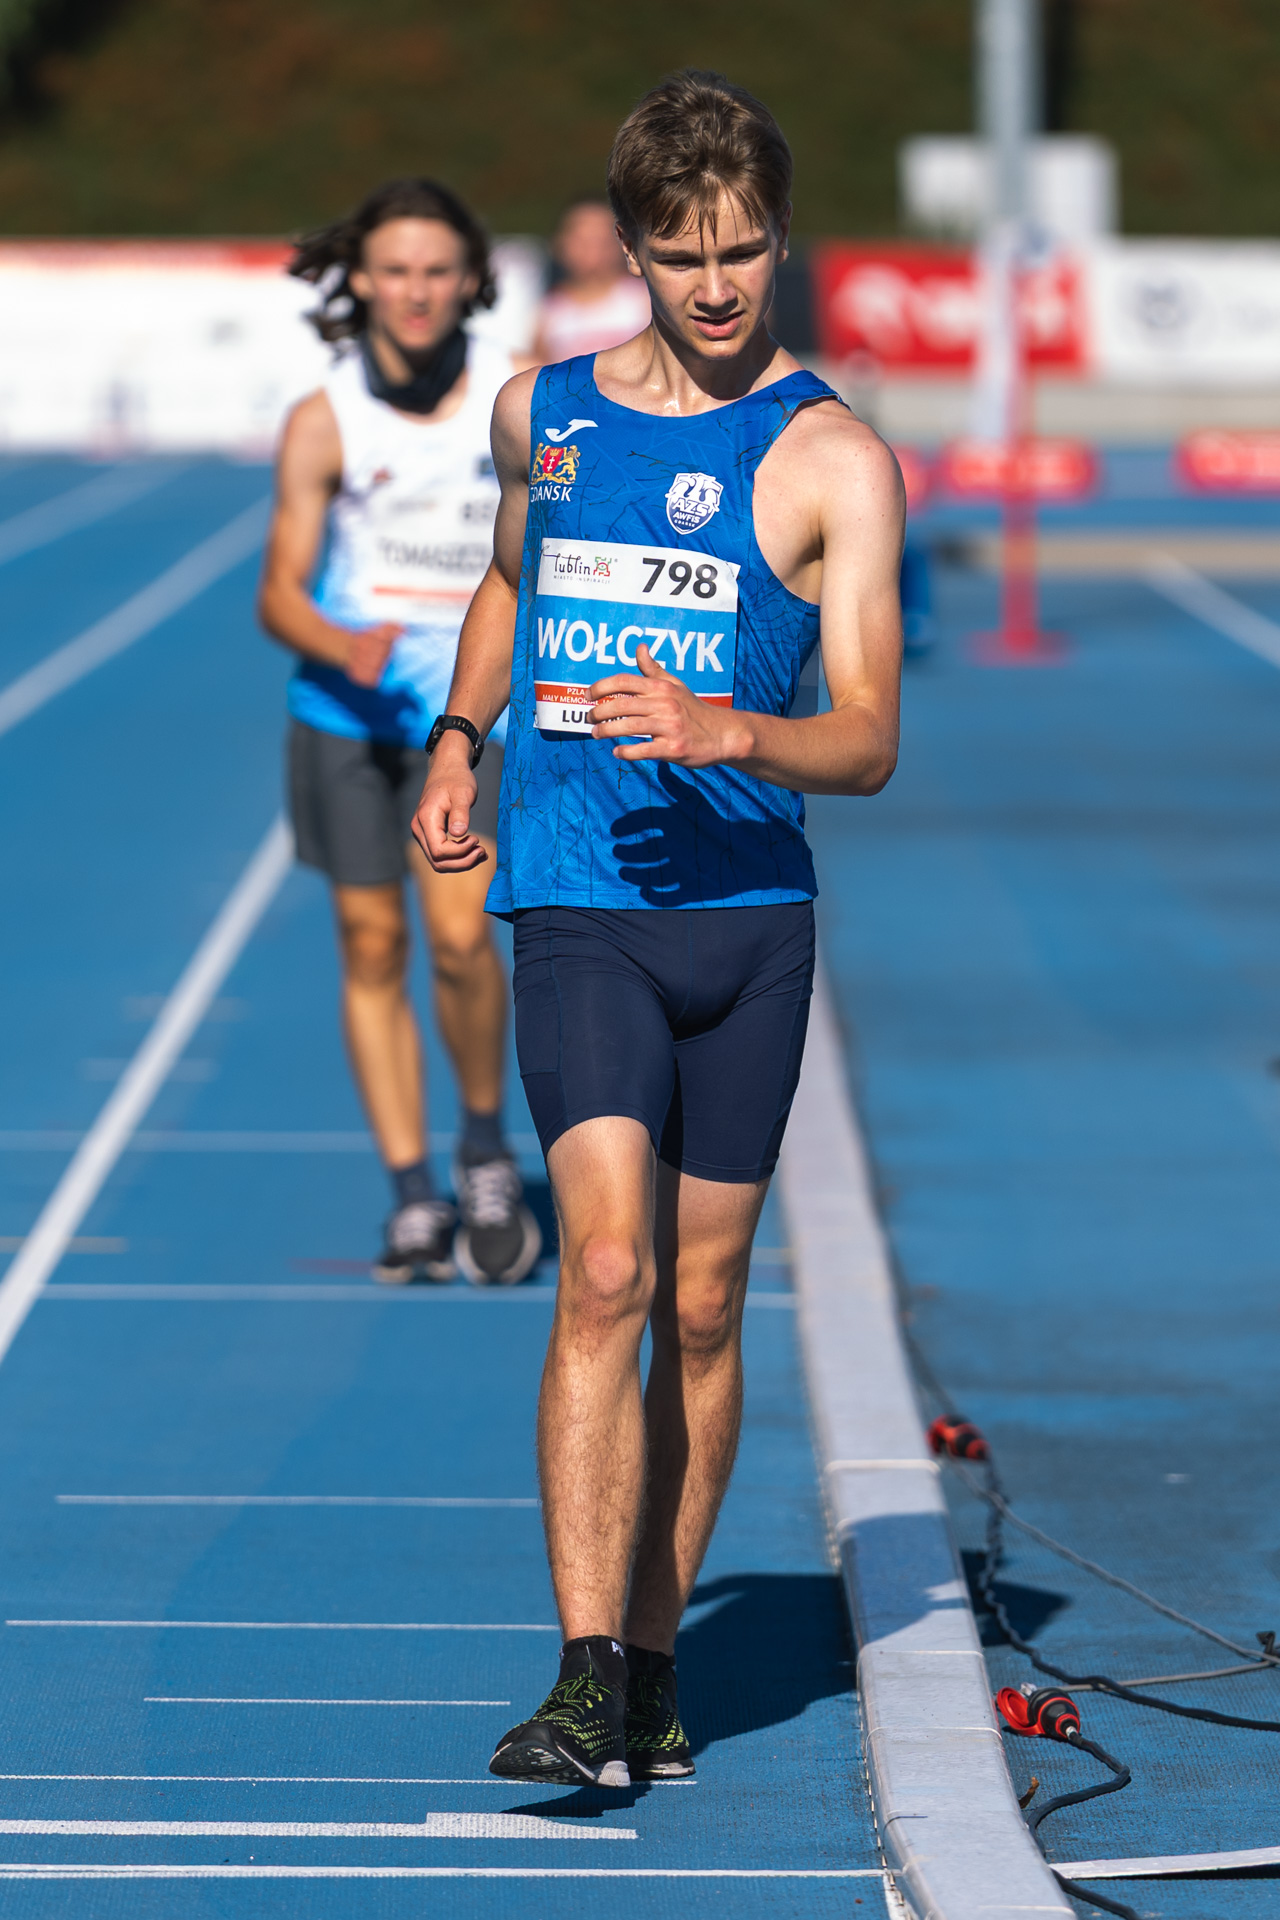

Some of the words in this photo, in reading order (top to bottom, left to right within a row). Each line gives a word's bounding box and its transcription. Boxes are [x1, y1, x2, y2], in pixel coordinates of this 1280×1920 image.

[671, 497, 711, 517] AZS
[642, 557, 719, 600] 798
[537, 617, 726, 673] WOŁCZYK
[566, 687, 586, 696] PZLA
